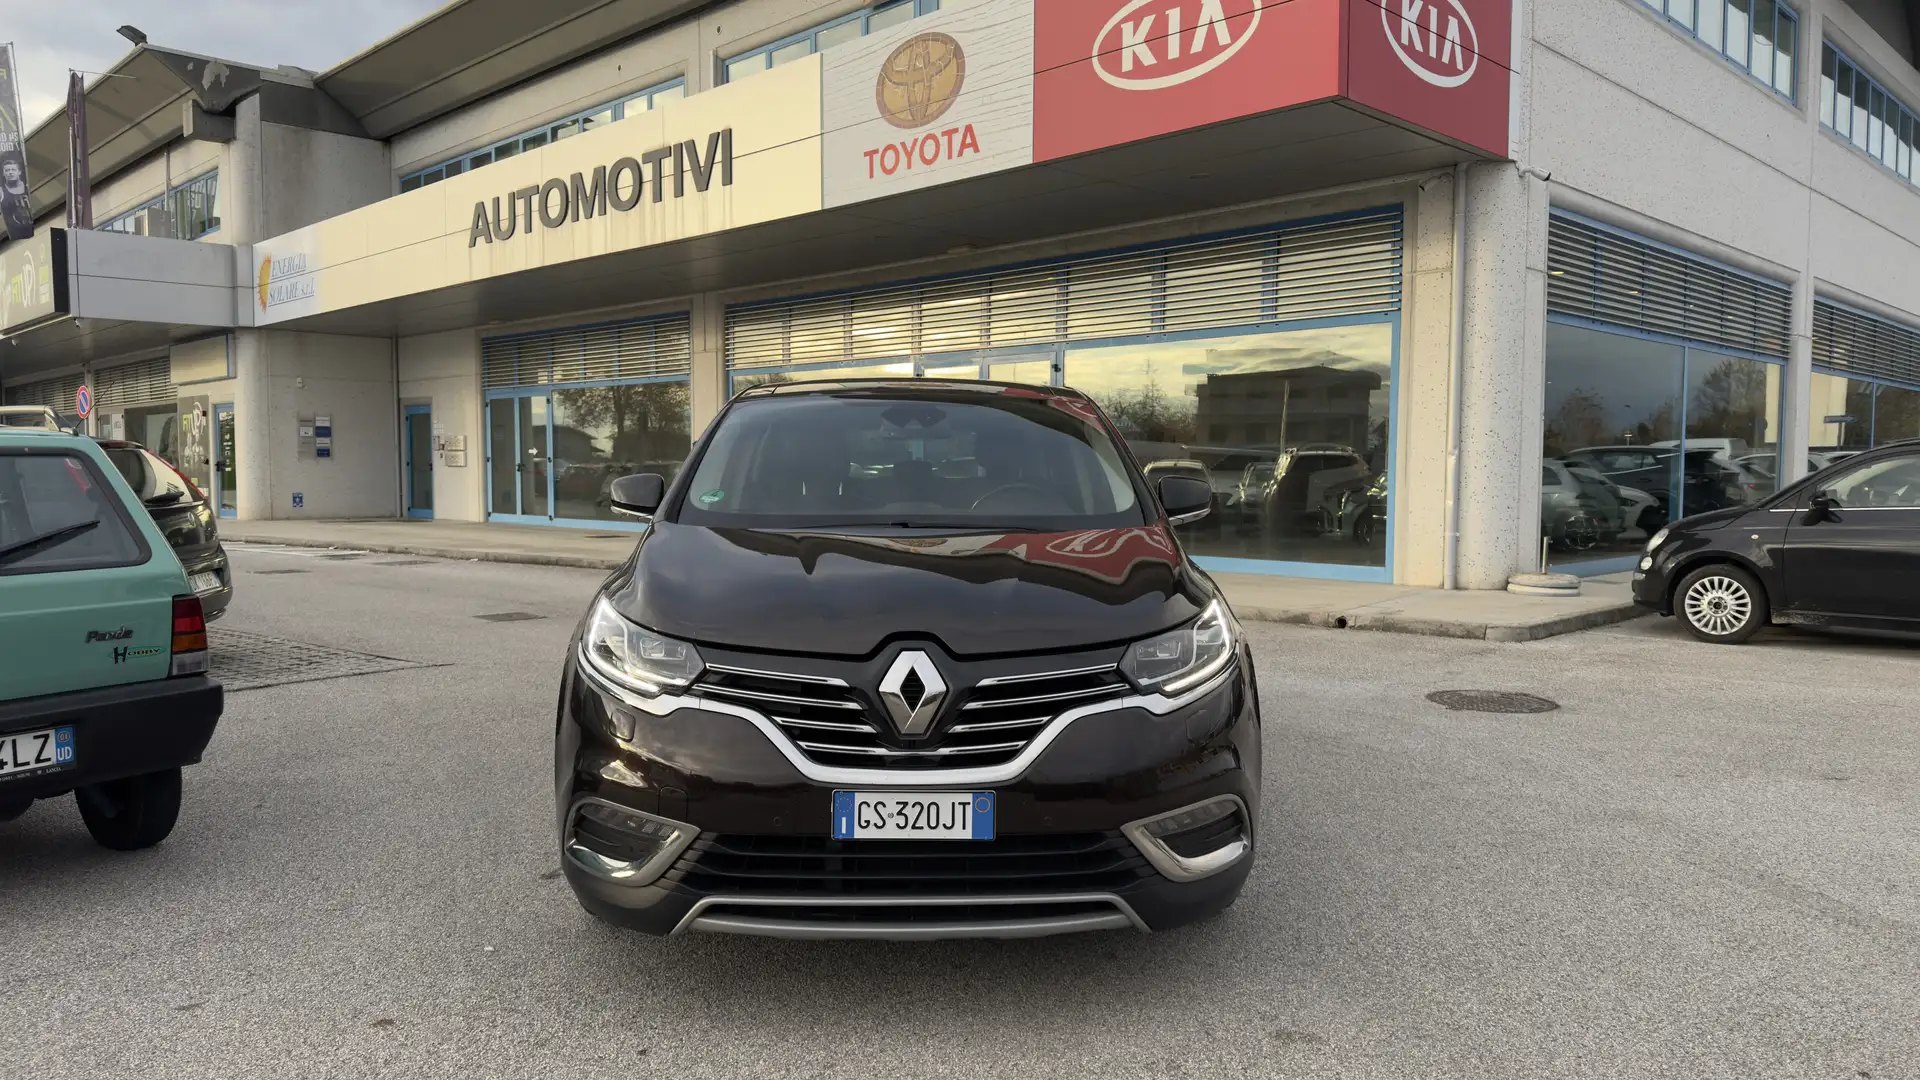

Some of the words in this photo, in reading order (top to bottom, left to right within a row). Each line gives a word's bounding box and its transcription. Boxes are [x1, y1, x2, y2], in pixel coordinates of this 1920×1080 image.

[1120, 0, 1232, 73] KIA
[1400, 0, 1465, 72] KIA
[863, 123, 980, 179] TOYOTA
[468, 128, 733, 248] AUTOMOTIVI
[85, 626, 134, 643] Panda
[57, 746, 73, 761] UD
